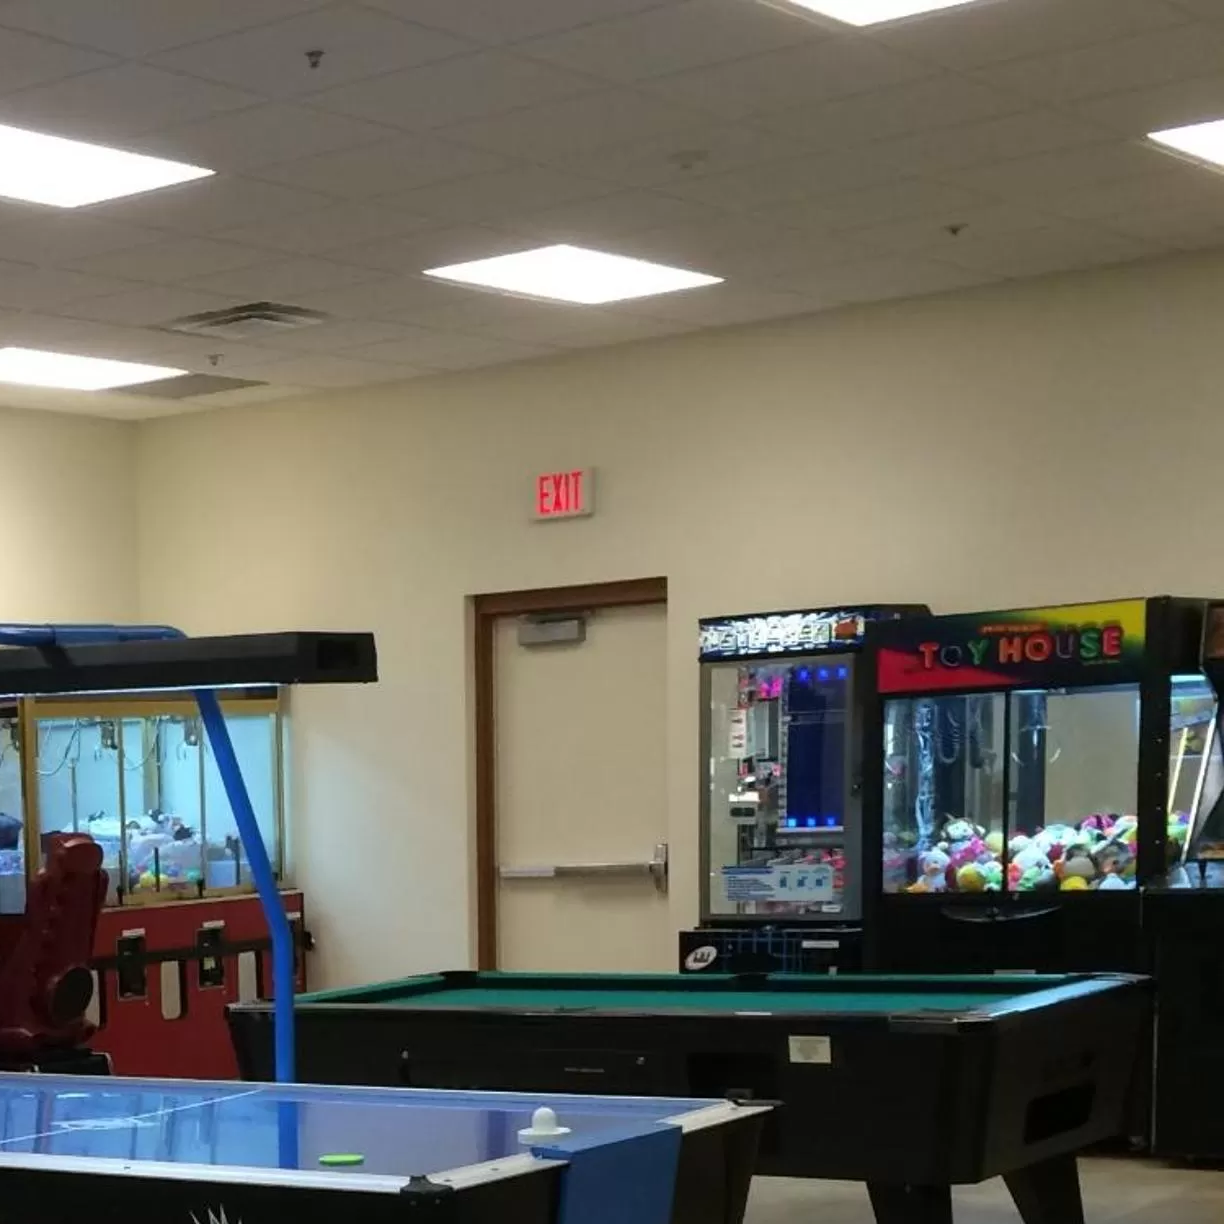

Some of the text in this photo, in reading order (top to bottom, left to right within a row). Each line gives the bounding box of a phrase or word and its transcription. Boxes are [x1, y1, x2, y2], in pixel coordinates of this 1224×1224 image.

[539, 470, 583, 513] EXIT
[919, 623, 1122, 668] TOY HOUSE
